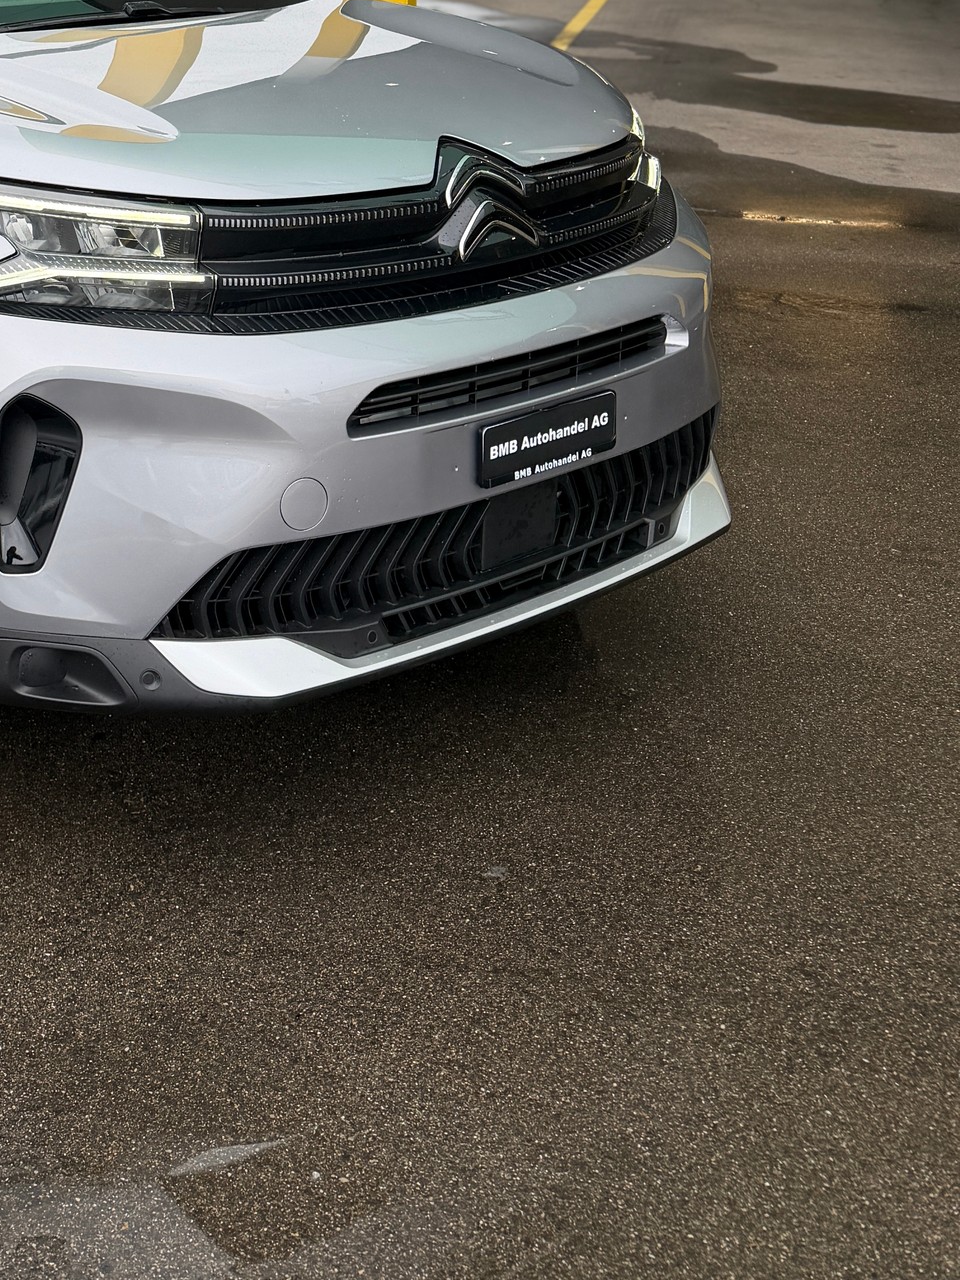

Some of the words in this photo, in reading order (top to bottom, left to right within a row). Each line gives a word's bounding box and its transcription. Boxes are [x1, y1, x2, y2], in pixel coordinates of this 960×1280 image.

[489, 439, 518, 460] BMB
[520, 417, 589, 451] Autohandel
[591, 412, 609, 429] AG
[514, 467, 532, 481] BMB
[534, 451, 579, 474] Autohandel
[580, 447, 592, 459] AG
